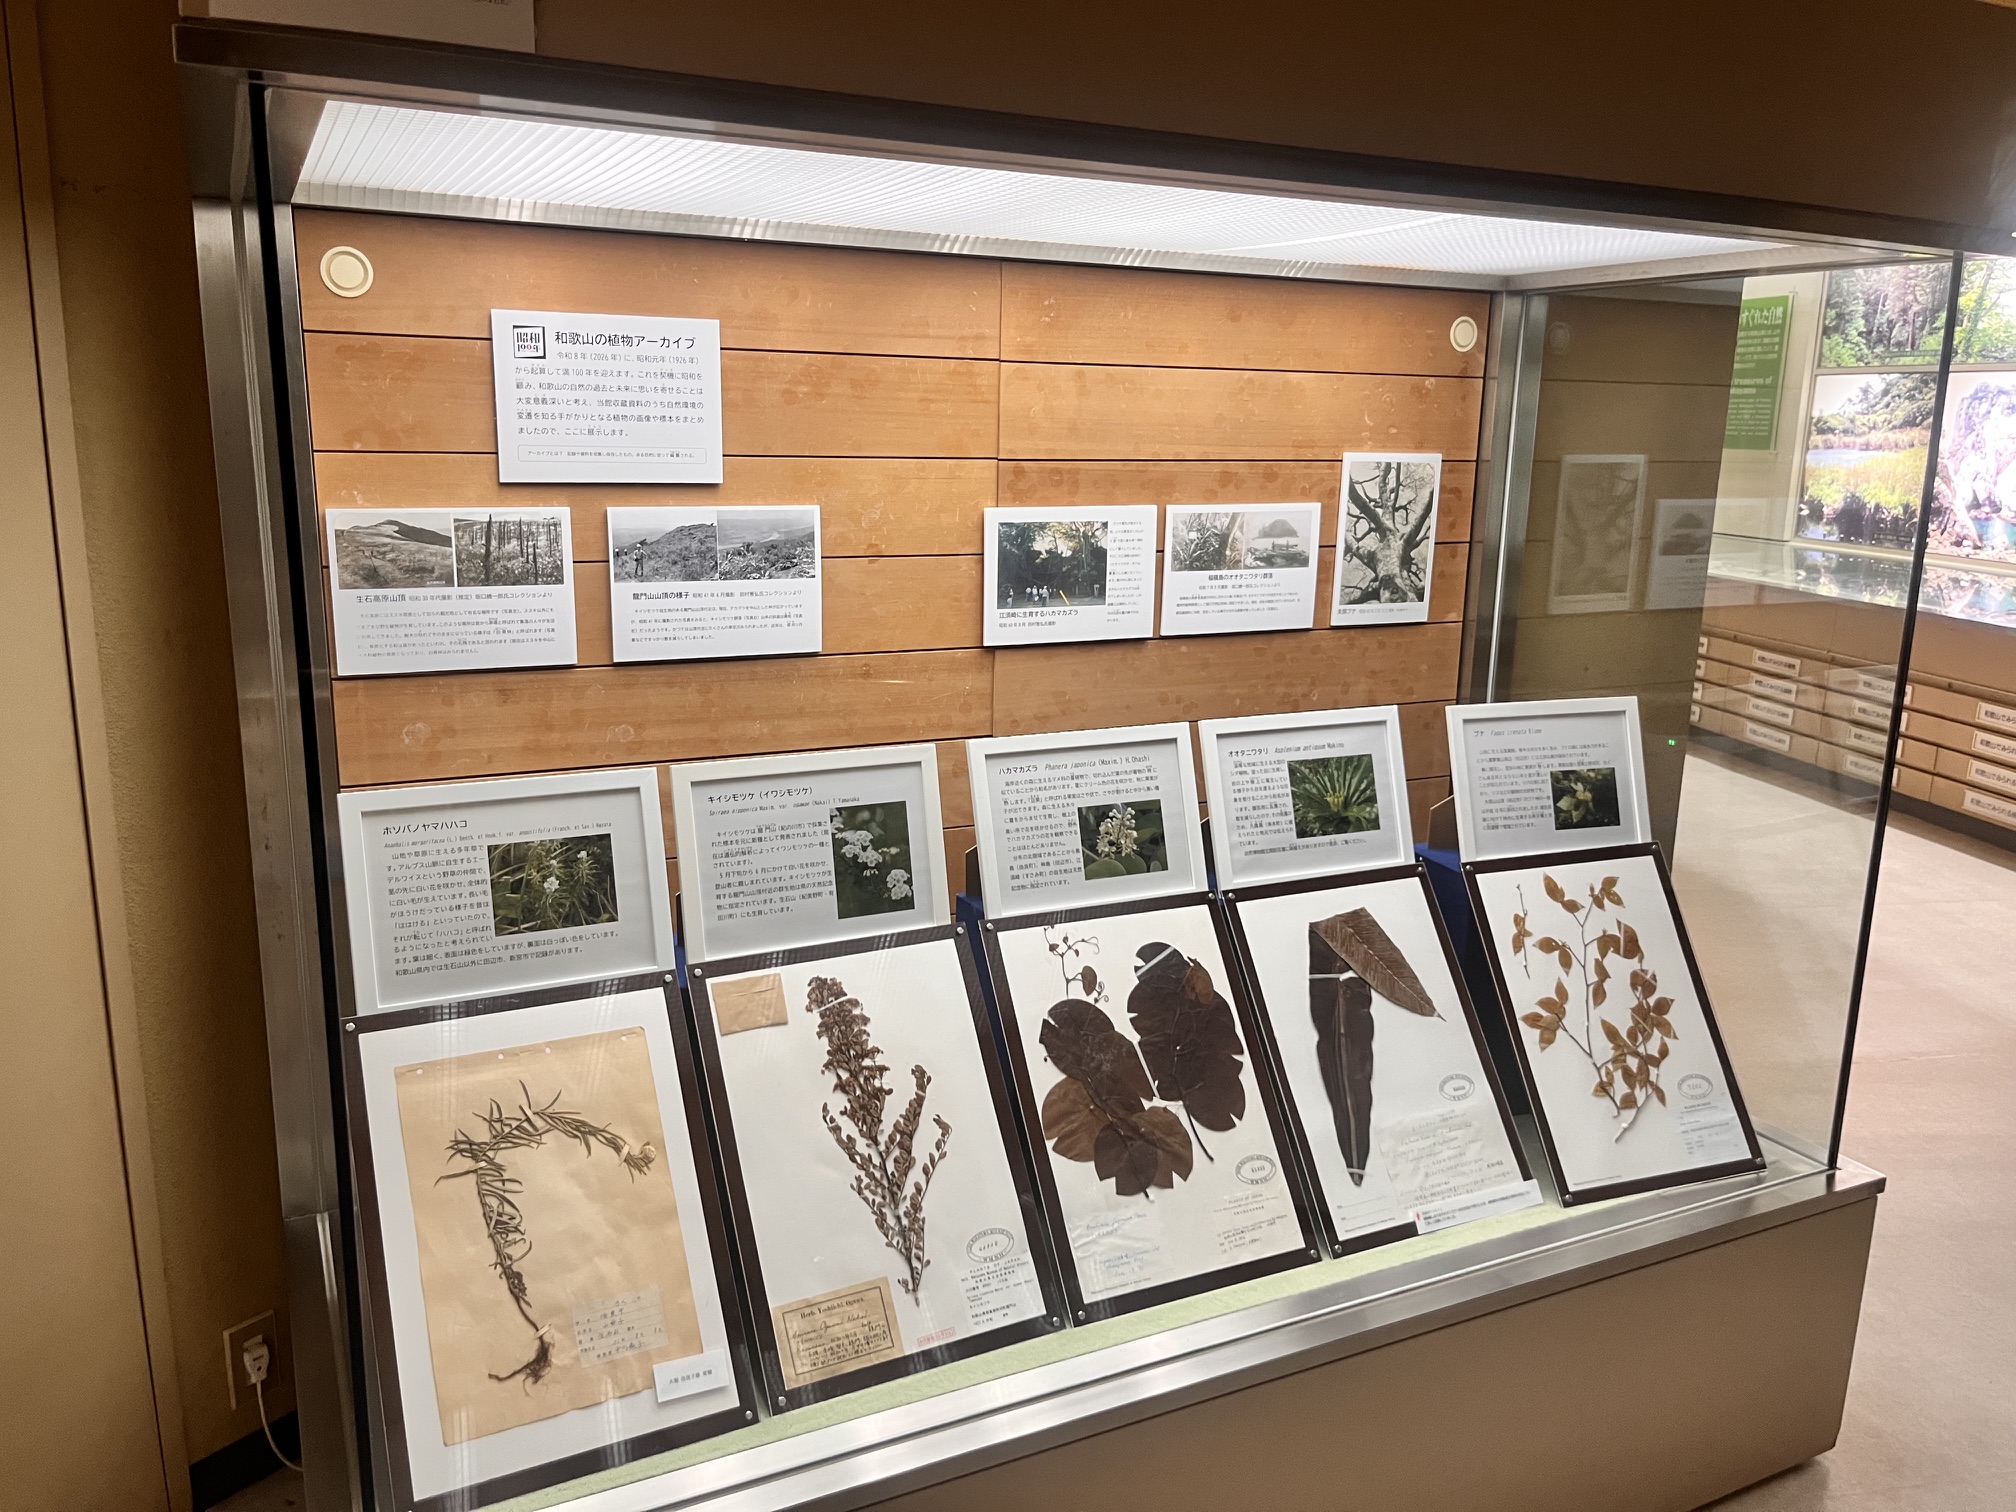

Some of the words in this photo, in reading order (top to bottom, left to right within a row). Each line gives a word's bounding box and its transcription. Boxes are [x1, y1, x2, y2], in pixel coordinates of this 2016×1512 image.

[516, 332, 540, 344] 昭和
[554, 331, 697, 349] 和歌山の植物アーカイブ
[518, 426, 629, 436] ましたので、ここに展示します。
[356, 594, 406, 604] 生石高原山頂
[632, 592, 690, 600] 龍門山山頂の様子
[1228, 748, 1268, 758] オオタニワタリ
[998, 765, 1038, 775] ハカマカズラ
[1044, 762, 1068, 771] Phanera
[1070, 760, 1096, 770] japonica
[707, 786, 814, 804] キイシモツケ（イワシモツケ）
[382, 820, 468, 836] ホソバノヤマハハコ
[392, 844, 484, 860] 山地や草原に生える多年草で
[386, 856, 485, 872] す。アルプス山脈に自生するエー
[387, 868, 486, 883] デルワイスという野草の仲間で、
[390, 890, 489, 907] に白い毛が生えています。長い毛
[394, 935, 492, 953] るようになったと考えられてい
